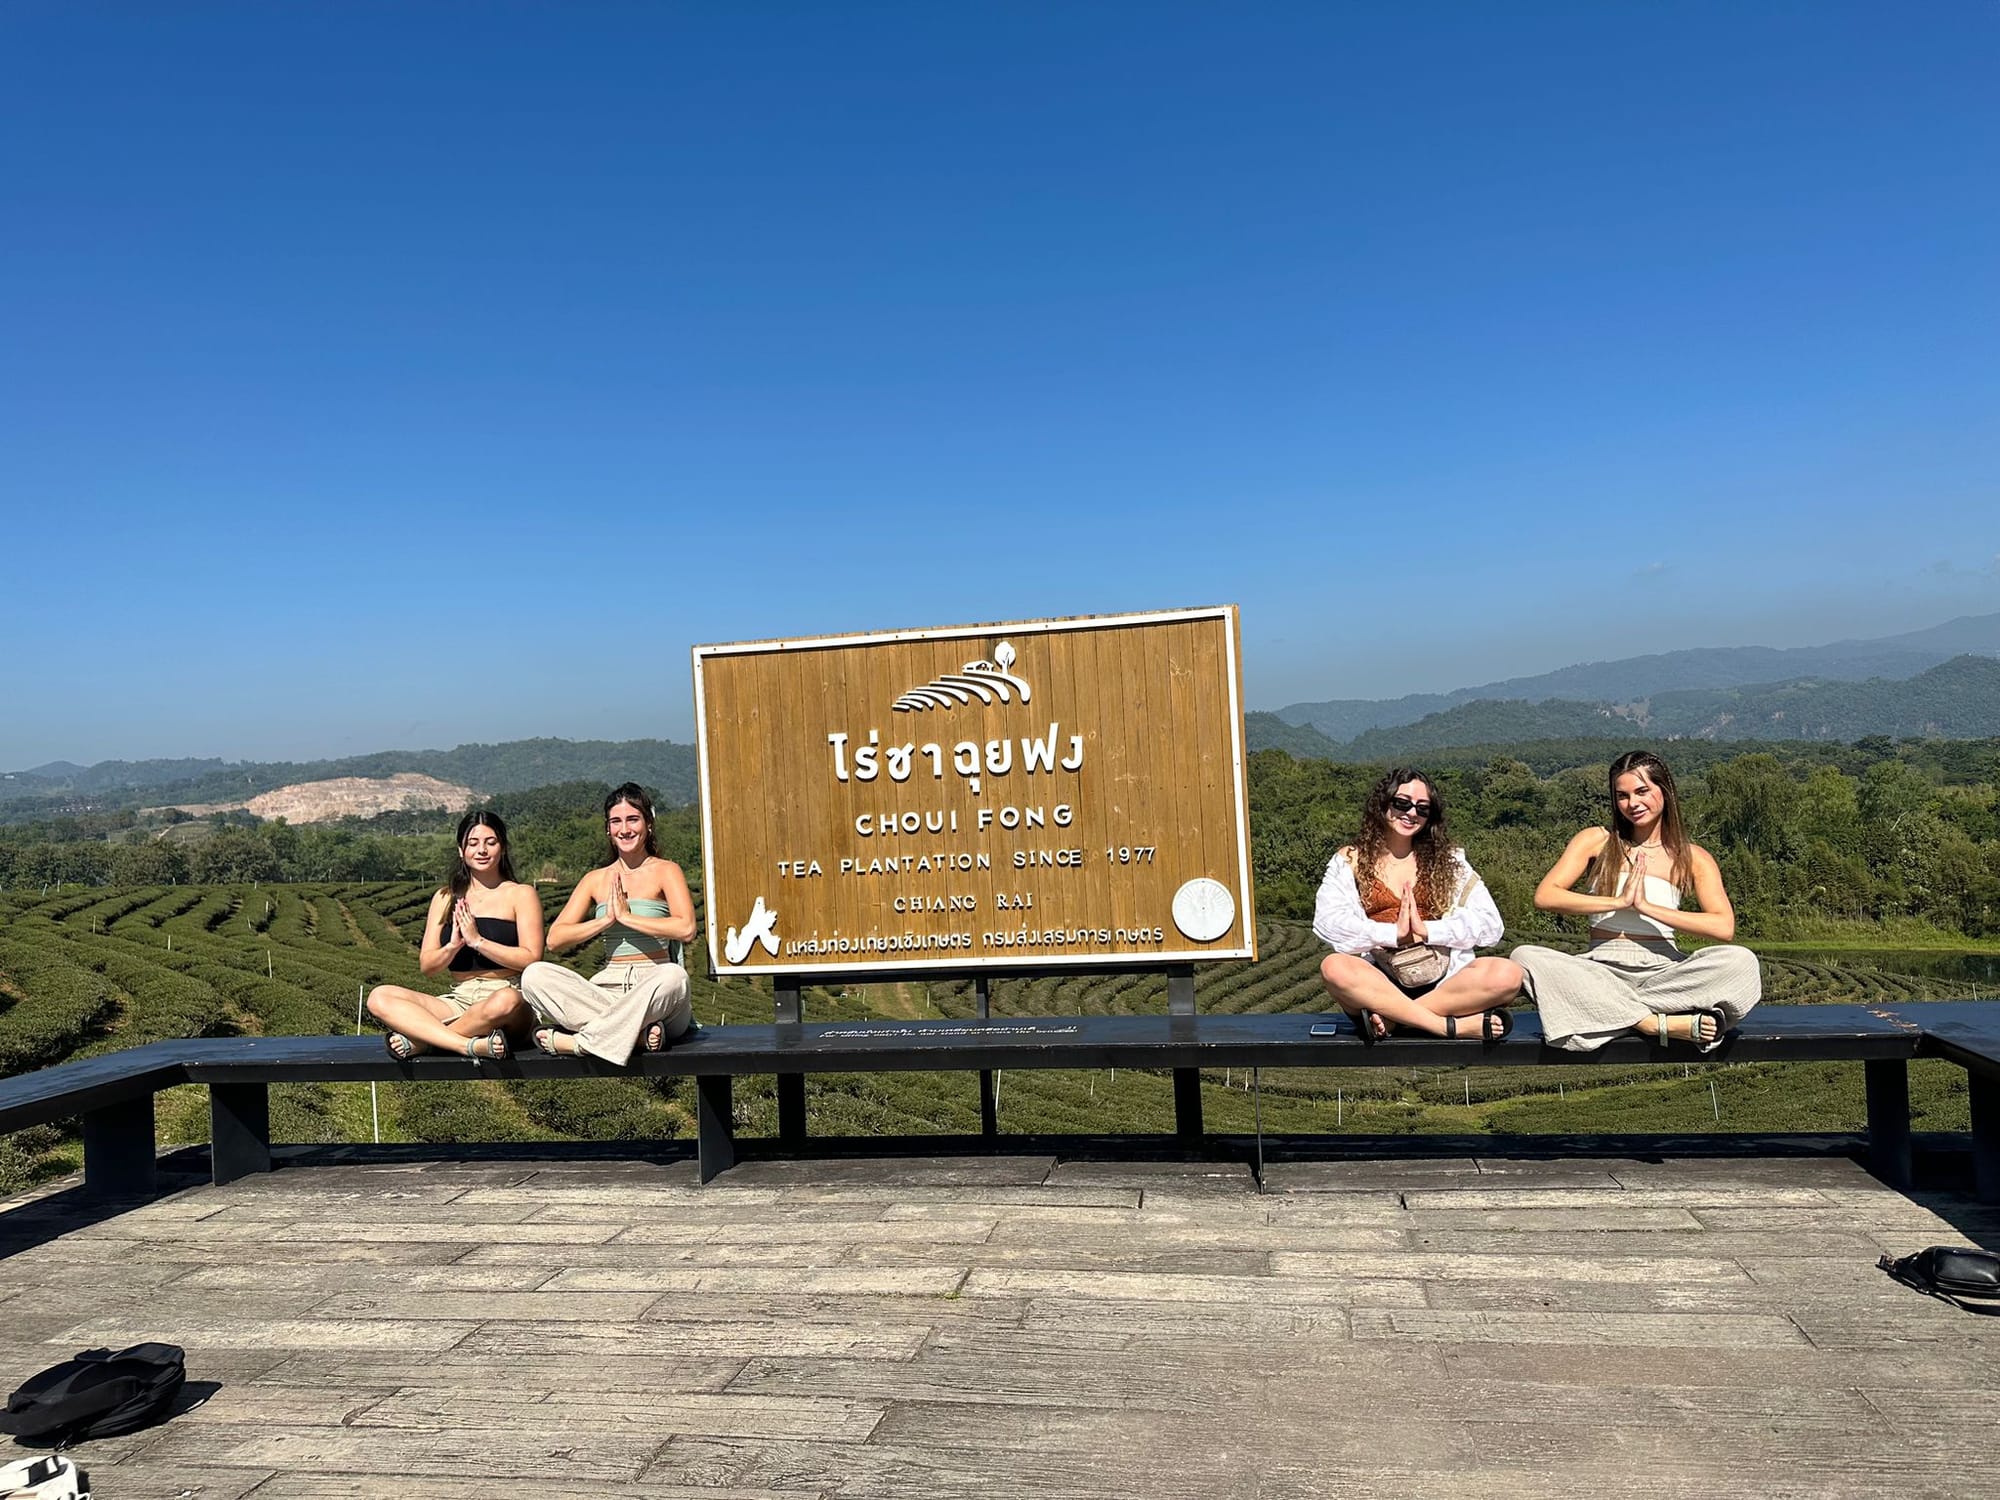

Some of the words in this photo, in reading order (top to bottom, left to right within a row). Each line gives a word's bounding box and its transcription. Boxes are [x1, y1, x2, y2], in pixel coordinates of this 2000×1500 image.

[827, 721, 1084, 794] ไร่ชาฉุยฟง
[855, 809, 957, 835] CHOUI
[977, 804, 1074, 829] FONG
[777, 859, 824, 877] TEA
[840, 852, 991, 874] PLANTATION
[1012, 848, 1082, 868] SINCE
[1105, 846, 1156, 864] 1977
[893, 894, 977, 912] CHIANG
[996, 892, 1034, 909] RAI
[786, 924, 973, 955] แหล่งท่องเท่ยวเชิงเกษตร
